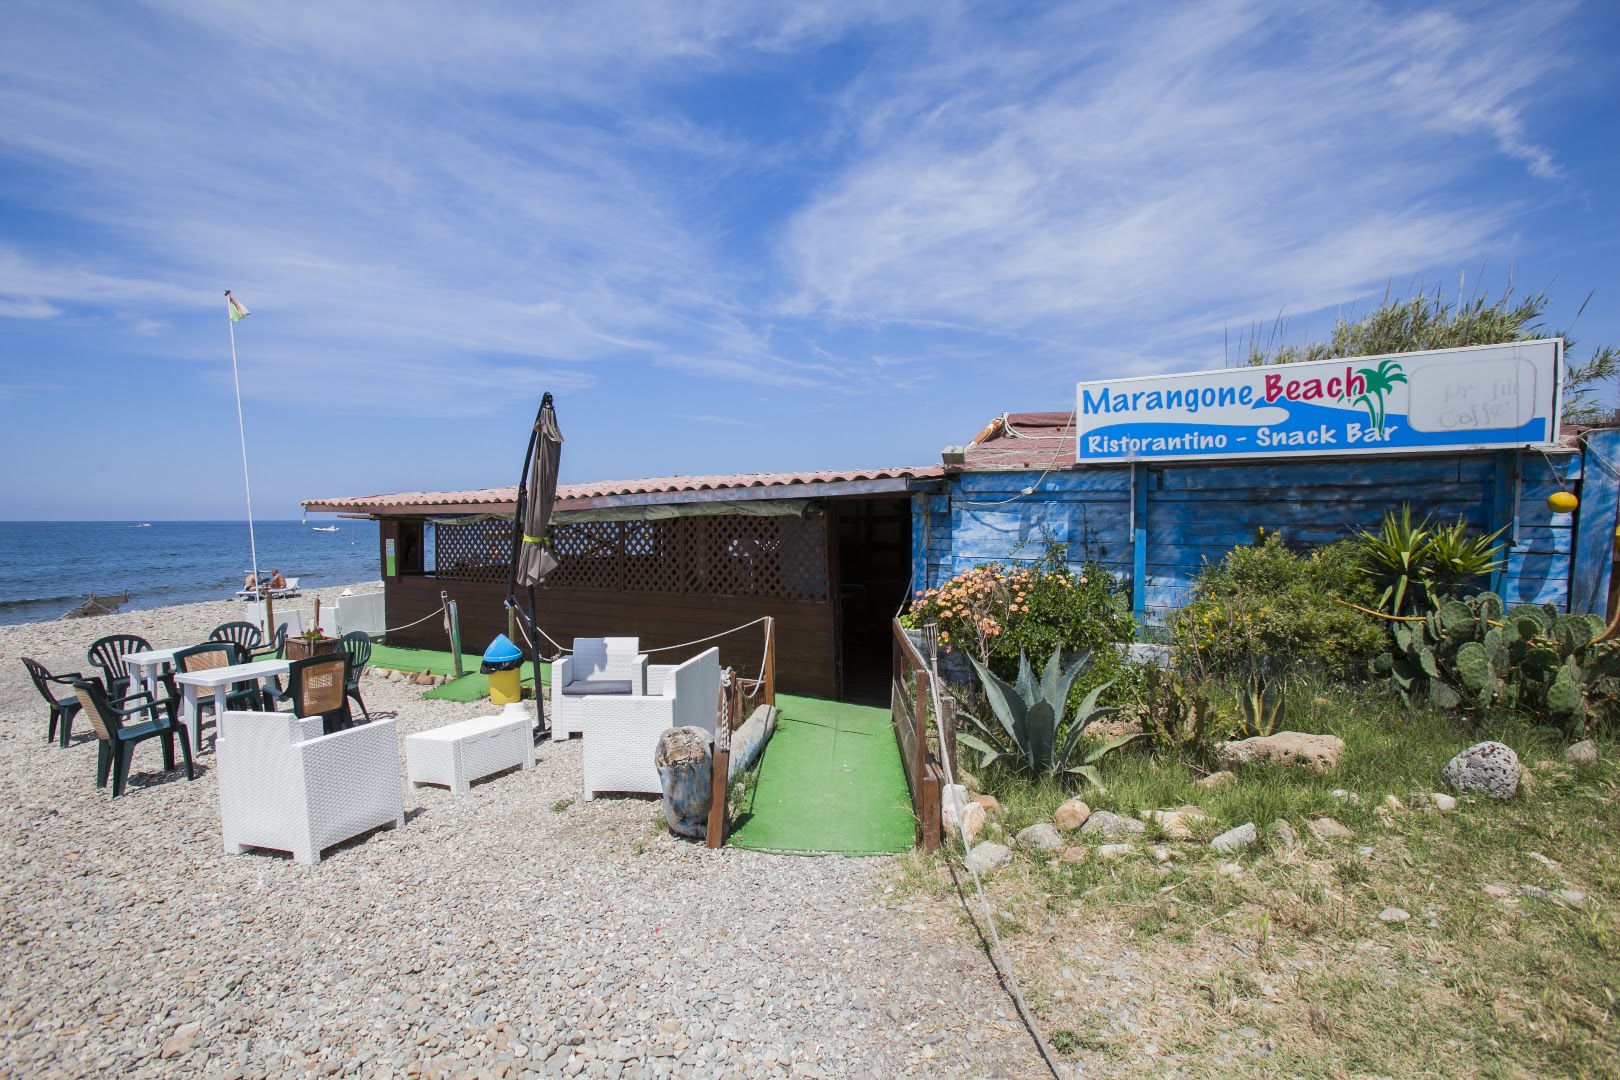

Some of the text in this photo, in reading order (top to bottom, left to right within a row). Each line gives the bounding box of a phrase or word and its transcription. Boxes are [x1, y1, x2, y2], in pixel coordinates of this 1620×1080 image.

[1083, 367, 1365, 414] Marangone Beach
[1088, 431, 1228, 453] Ristorantino
[1256, 424, 1337, 447] Snack
[1346, 423, 1399, 443] Bar
